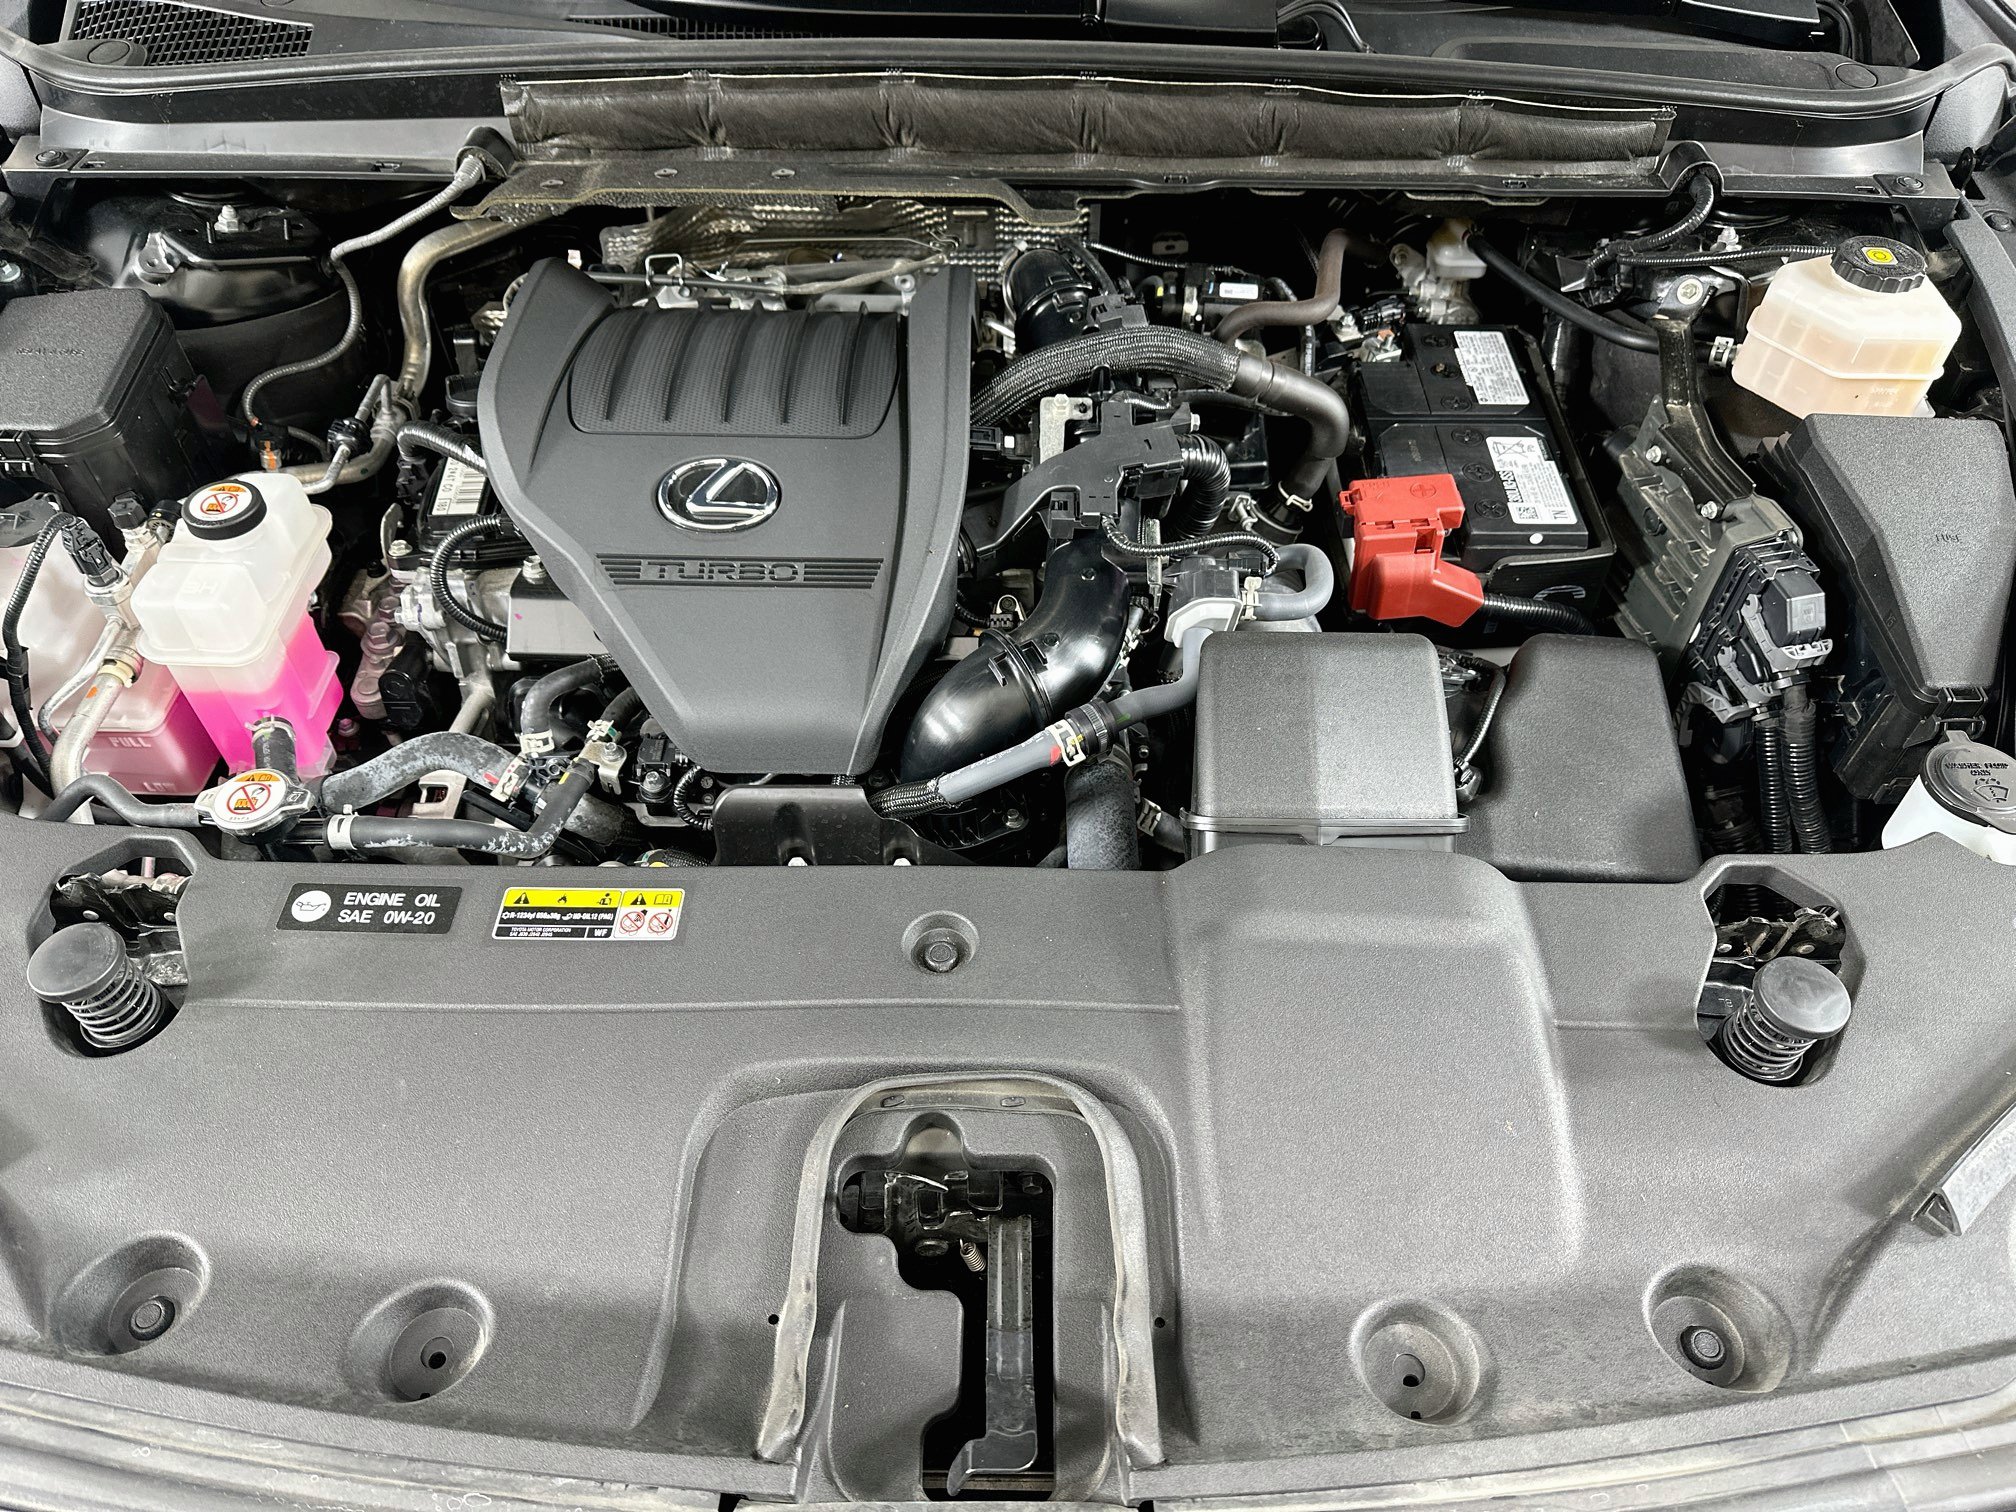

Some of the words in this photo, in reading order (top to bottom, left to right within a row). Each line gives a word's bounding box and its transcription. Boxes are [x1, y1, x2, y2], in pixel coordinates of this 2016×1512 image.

[647, 561, 799, 581] TURBO
[108, 736, 152, 748] FULL
[1944, 762, 1982, 770] WASHER
[343, 891, 406, 906] ENGINE
[414, 893, 441, 907] OIL
[337, 909, 374, 924] SAE
[383, 911, 436, 925] 0W-20
[594, 928, 608, 937] WF
